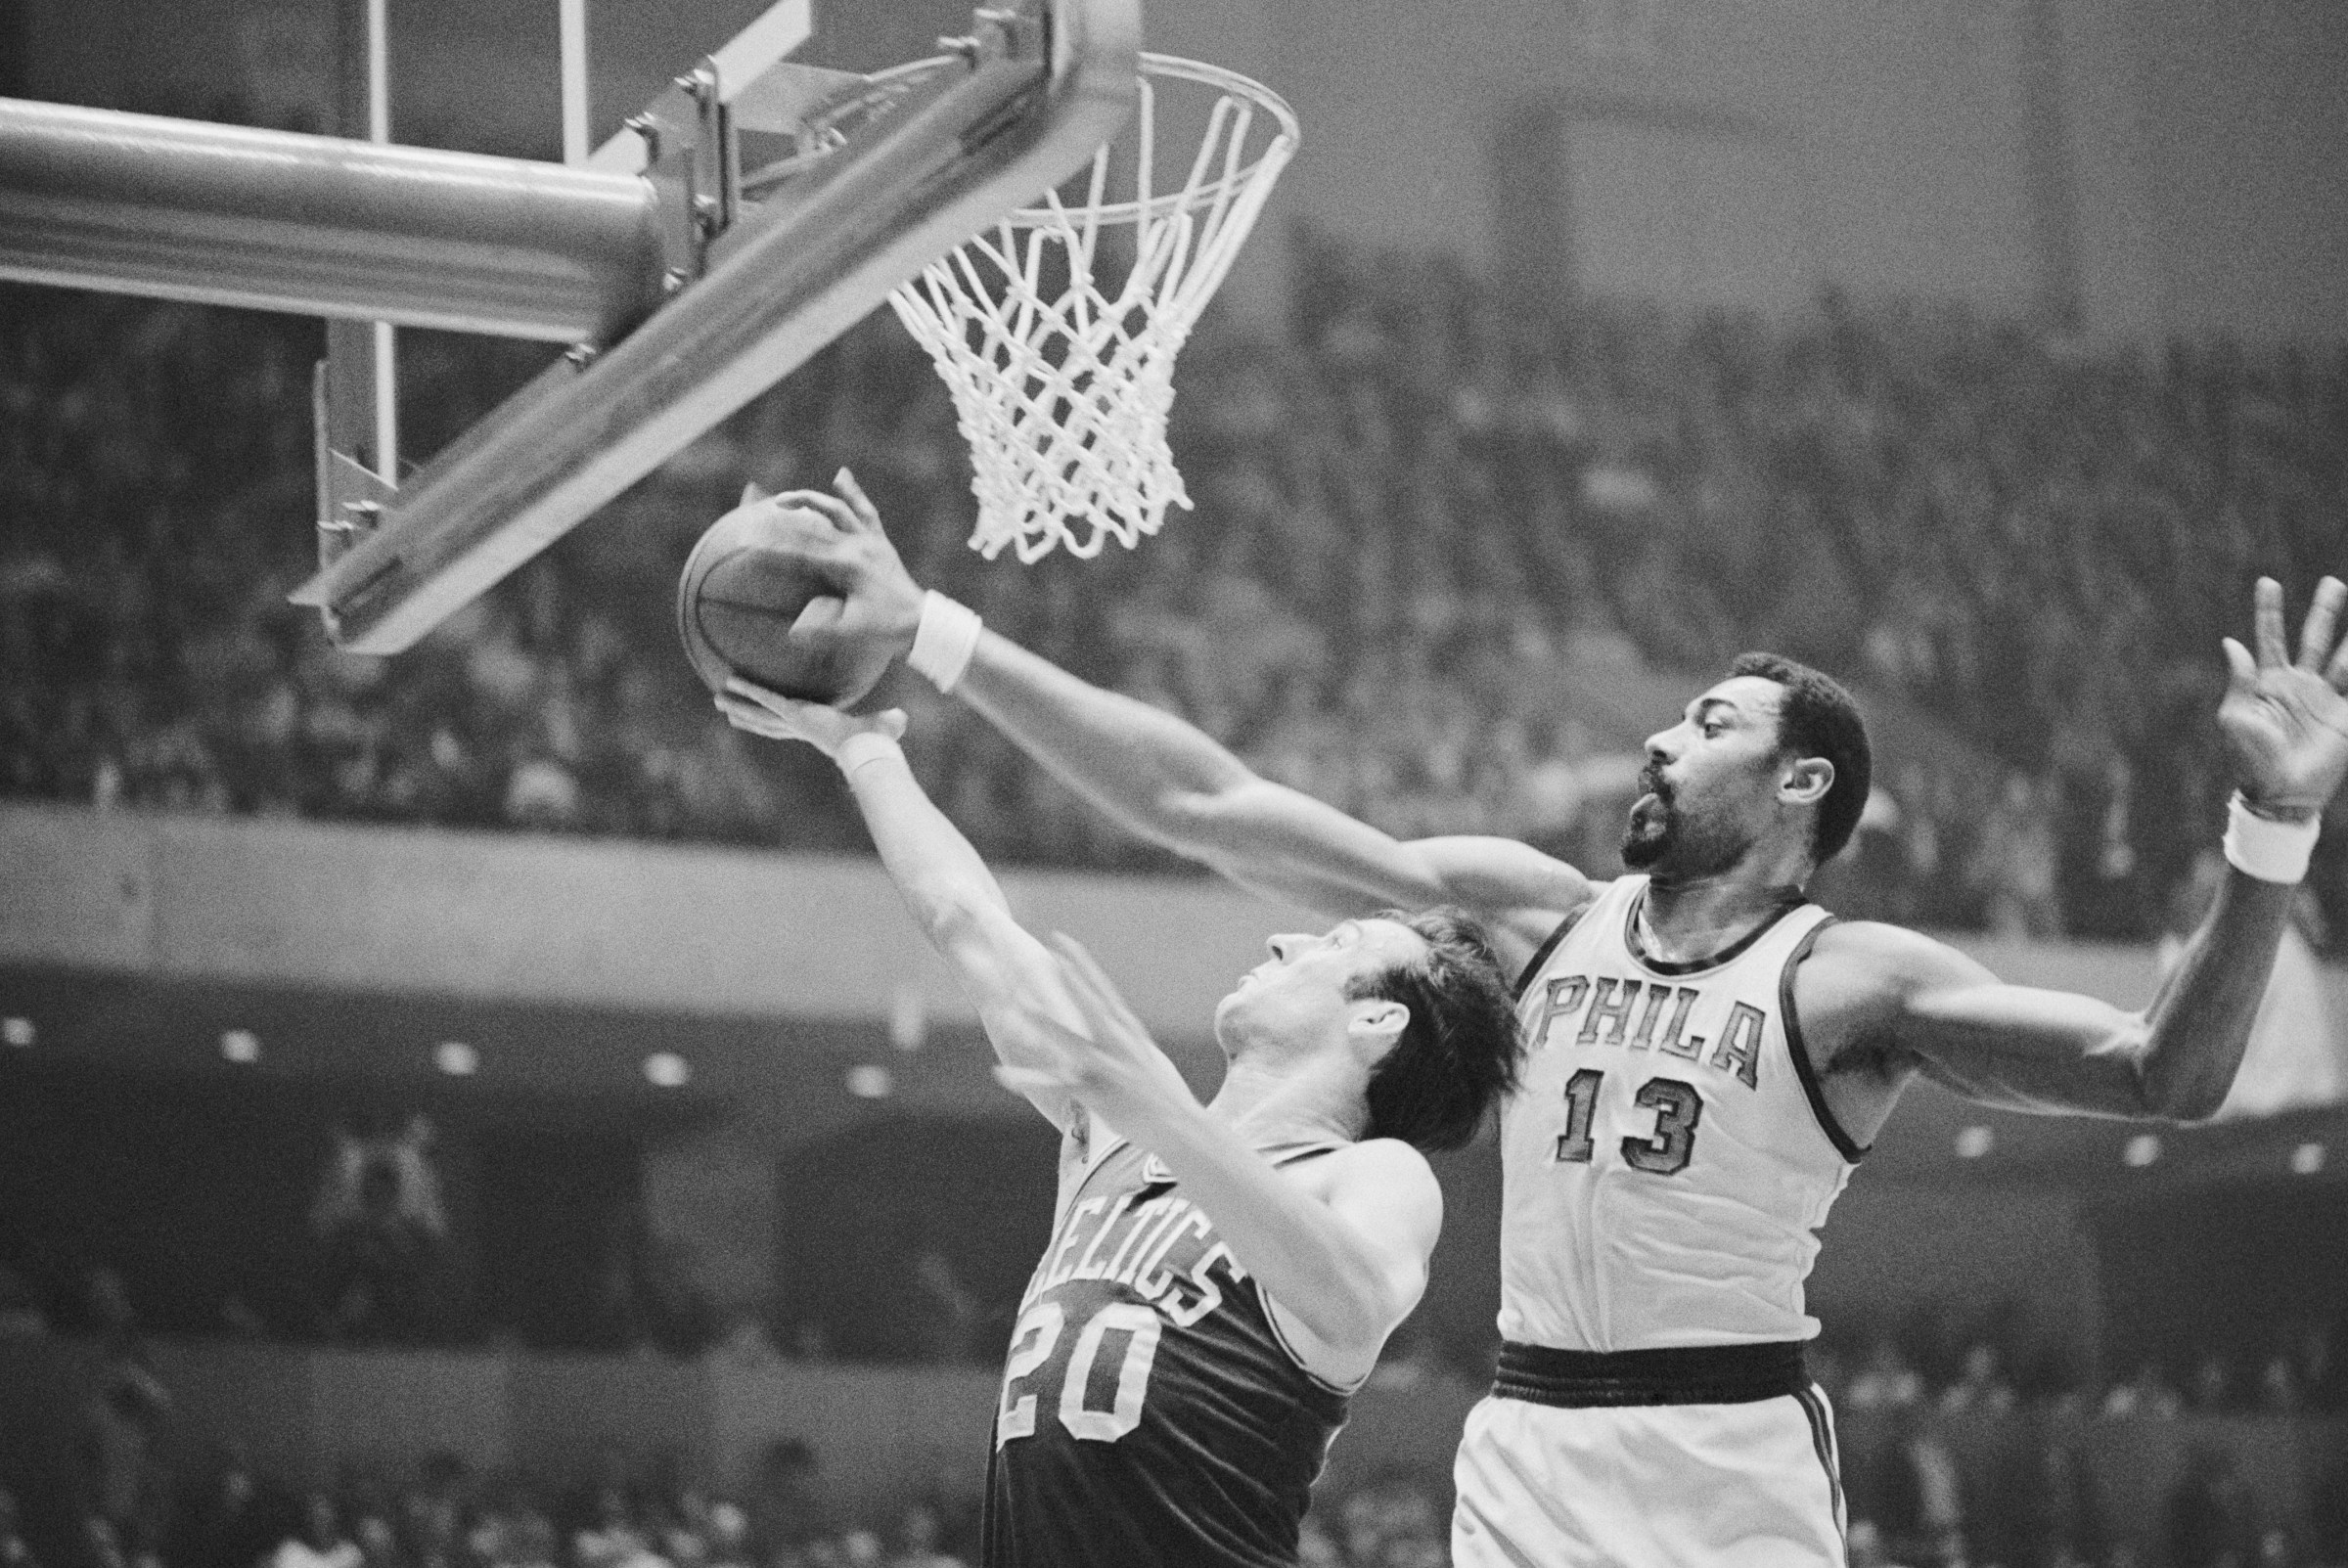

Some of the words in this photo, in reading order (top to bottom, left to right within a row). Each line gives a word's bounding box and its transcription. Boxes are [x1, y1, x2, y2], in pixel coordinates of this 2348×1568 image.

[1536, 975, 1766, 1091] PHILA
[1556, 1068, 1704, 1176] 13
[997, 1302, 1161, 1454] 20
